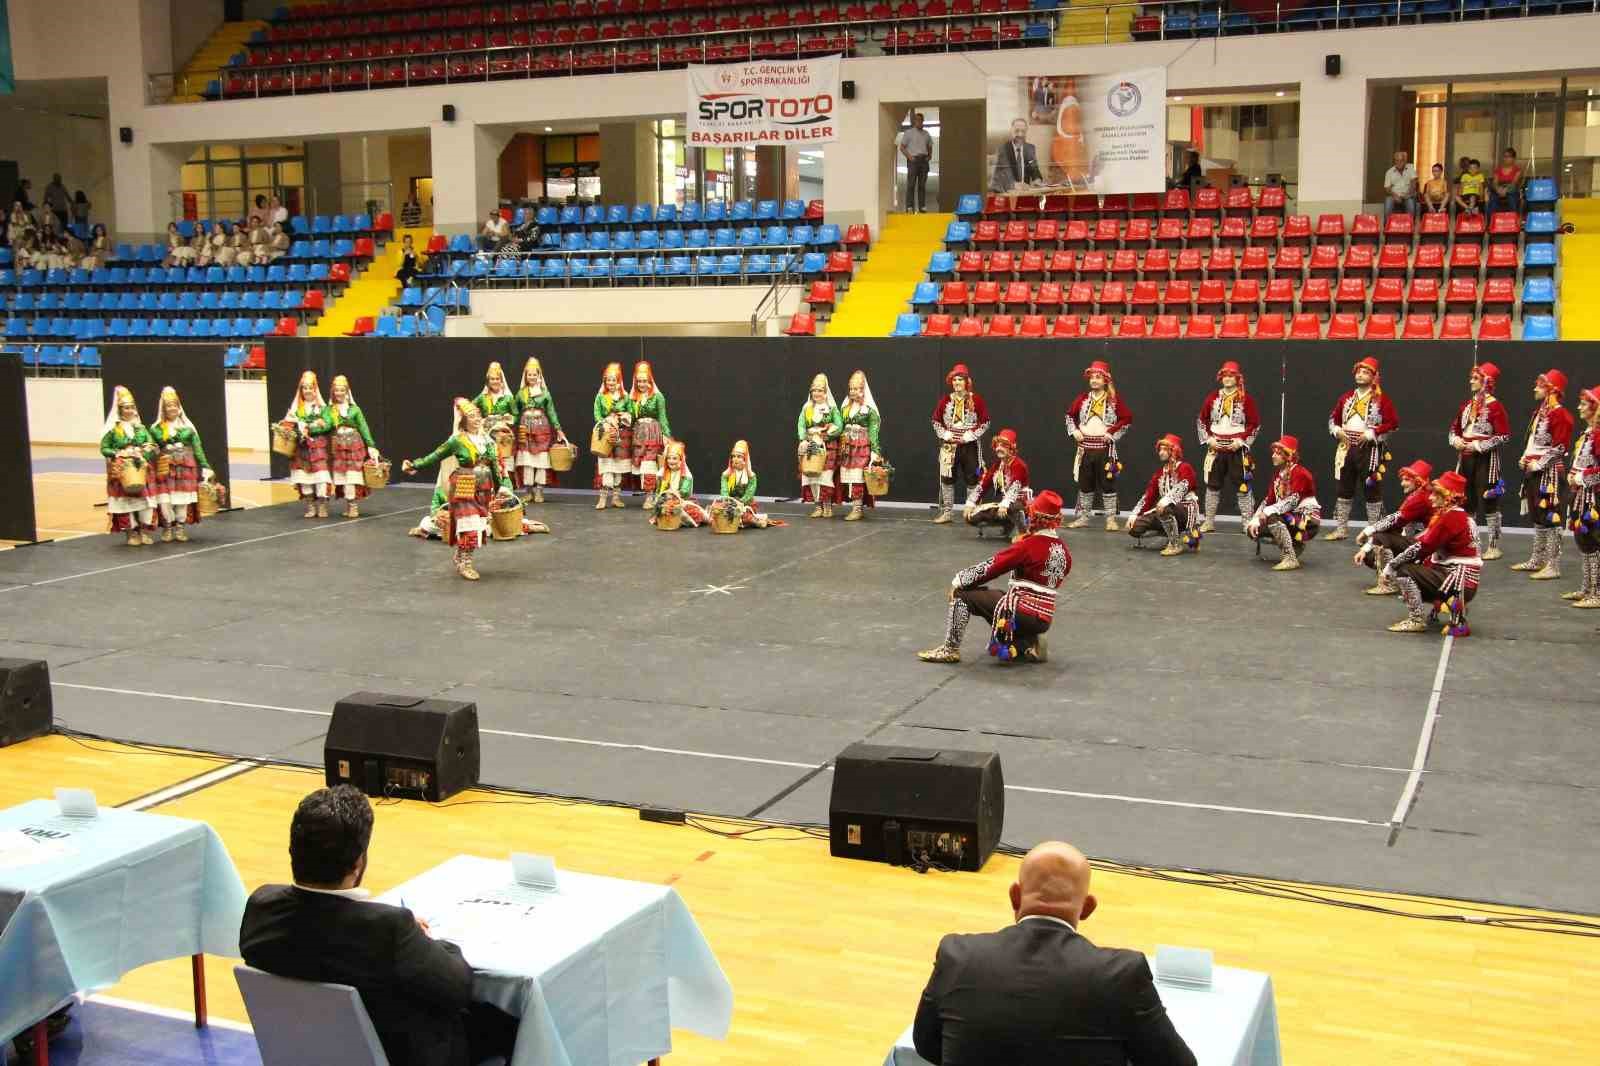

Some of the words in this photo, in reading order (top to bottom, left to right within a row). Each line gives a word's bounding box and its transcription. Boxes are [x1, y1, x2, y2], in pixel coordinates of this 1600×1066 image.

[743, 67, 758, 76] T.C.
[760, 64, 795, 76] GENÇLİK
[797, 63, 808, 74] VE
[740, 78, 763, 87] SPOR
[764, 75, 810, 86] BAKANLIĞI
[691, 130, 779, 144] BAŞARILAR
[784, 126, 833, 140] DİLER
